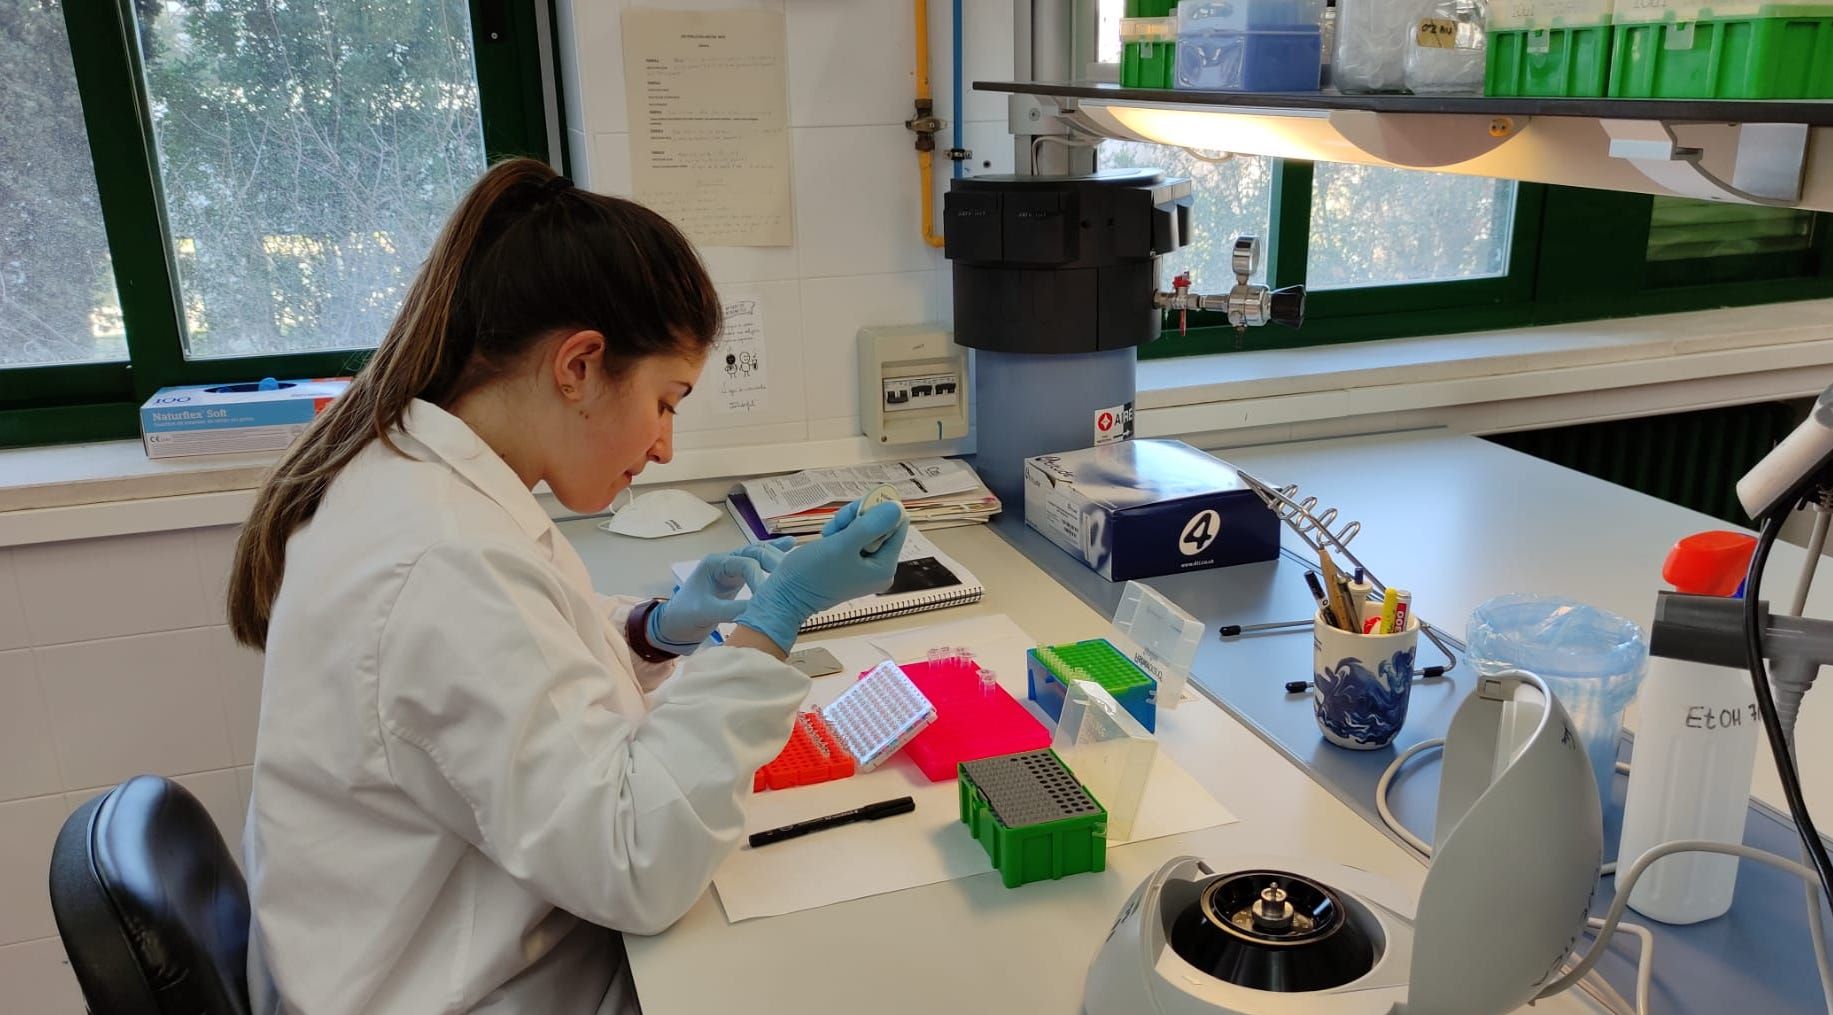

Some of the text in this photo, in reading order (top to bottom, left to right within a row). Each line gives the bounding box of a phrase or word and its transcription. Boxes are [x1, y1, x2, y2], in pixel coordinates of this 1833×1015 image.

[154, 396, 192, 405] 100
[152, 410, 203, 422] Naturflex
[206, 409, 227, 418] Soft
[1182, 511, 1213, 551] 4
[1685, 706, 1742, 730] EtOH
